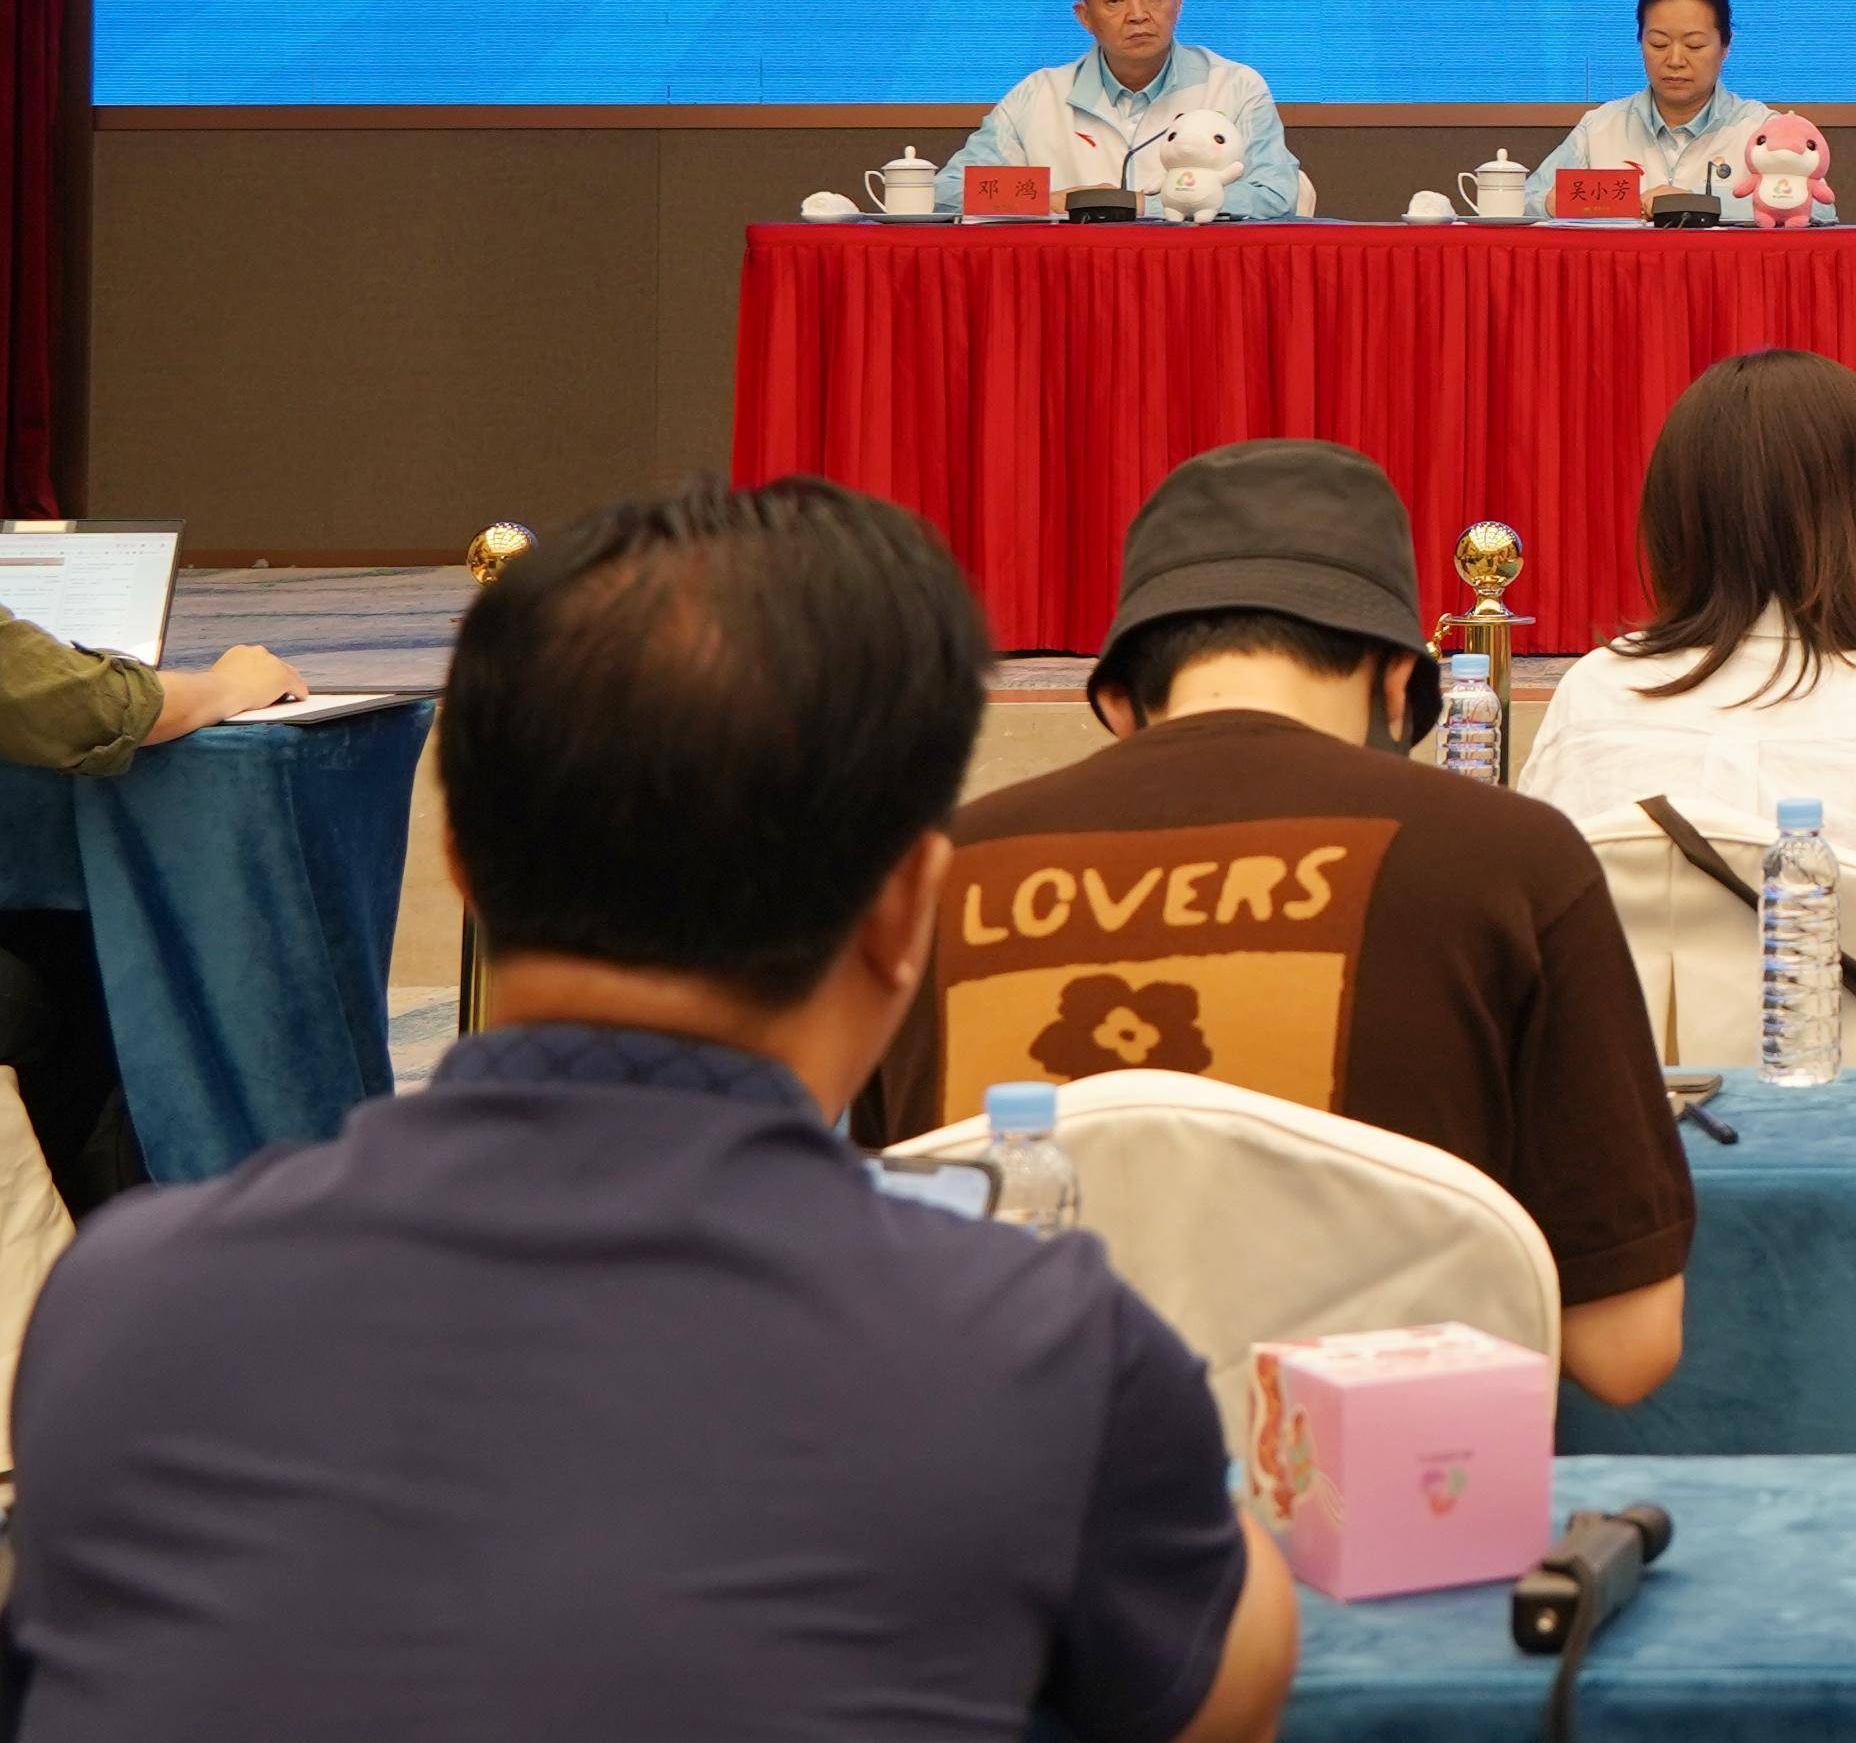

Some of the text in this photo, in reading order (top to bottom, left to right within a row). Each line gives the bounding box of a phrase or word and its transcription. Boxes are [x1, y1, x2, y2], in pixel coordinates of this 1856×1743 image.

[1569, 179, 1631, 201] 吴小芳
[961, 845, 1348, 947] LOVERS
